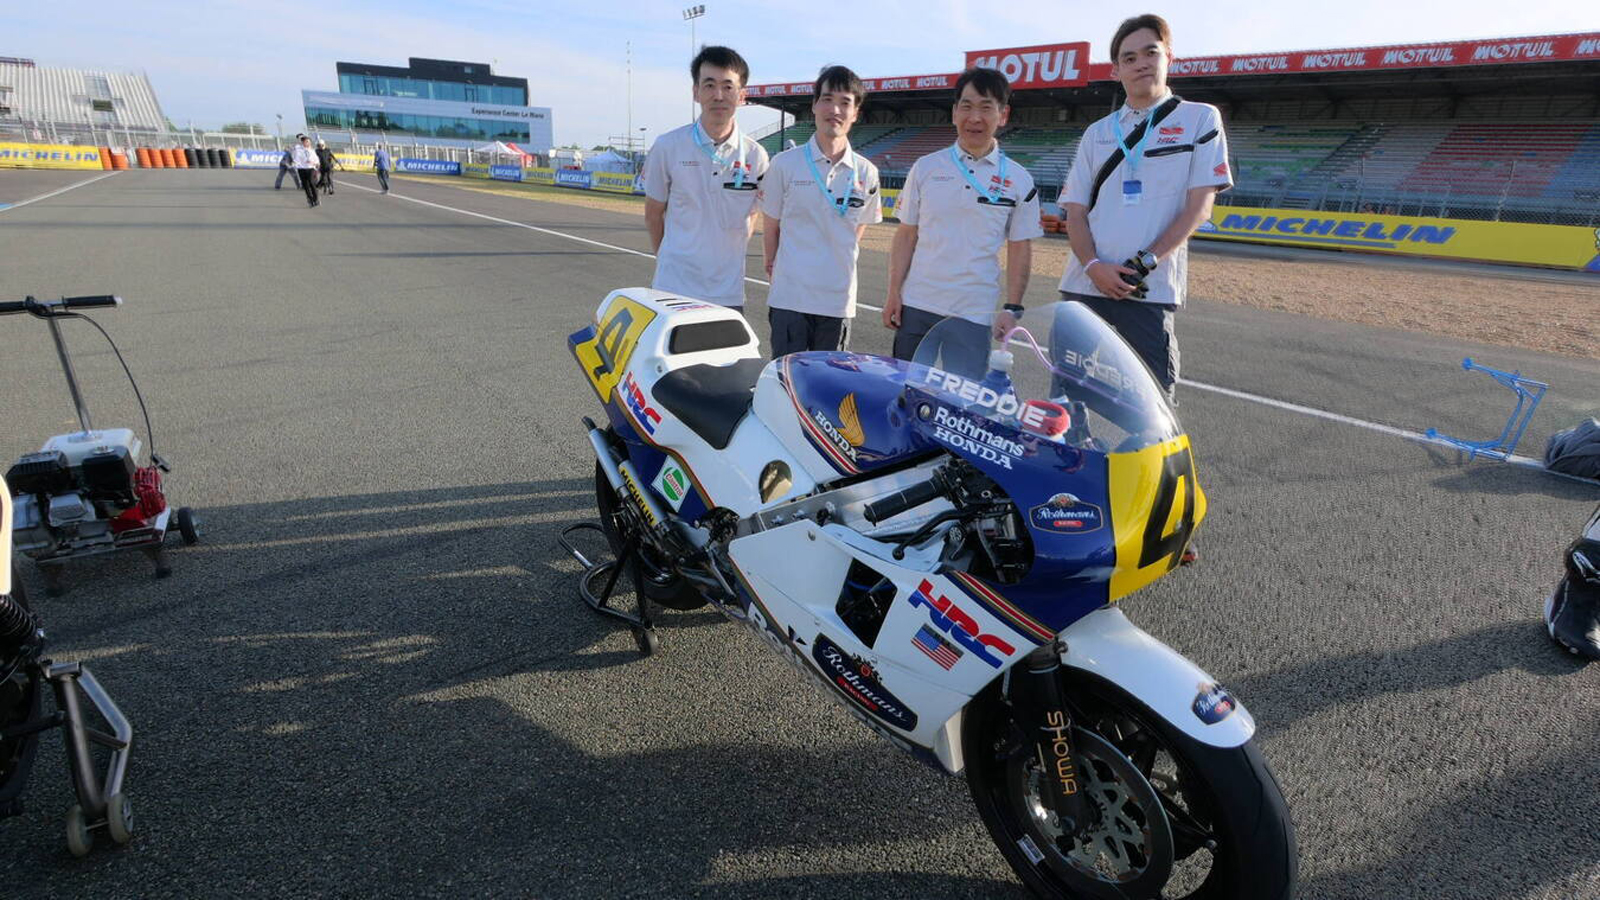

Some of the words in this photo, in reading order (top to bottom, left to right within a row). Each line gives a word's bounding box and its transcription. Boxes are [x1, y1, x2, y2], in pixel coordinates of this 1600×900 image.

[1303, 51, 1365, 69] MOTUL
[1381, 47, 1453, 65] MOTUL
[1472, 41, 1553, 60] MOTUL
[1231, 57, 1288, 72] MOTUL
[881, 78, 910, 89] MOTUL
[916, 76, 948, 87] MOTUL
[406, 162, 458, 172] MICHELIN
[560, 170, 590, 182] MICHELIN
[597, 176, 632, 187] MICHELIN
[1220, 213, 1457, 245] MICHELIN
[622, 371, 663, 436] HRC
[924, 367, 1048, 428] FREDDIE
[815, 411, 858, 463] HONDA
[933, 406, 1025, 458] Rothmans
[933, 426, 1013, 470] HONDA
[619, 467, 655, 523] MICHELIN
[1037, 507, 1097, 520] Rothmans
[908, 578, 1016, 669] HRC
[822, 646, 907, 722] Rothmans
[1047, 710, 1077, 795] SHOWA
